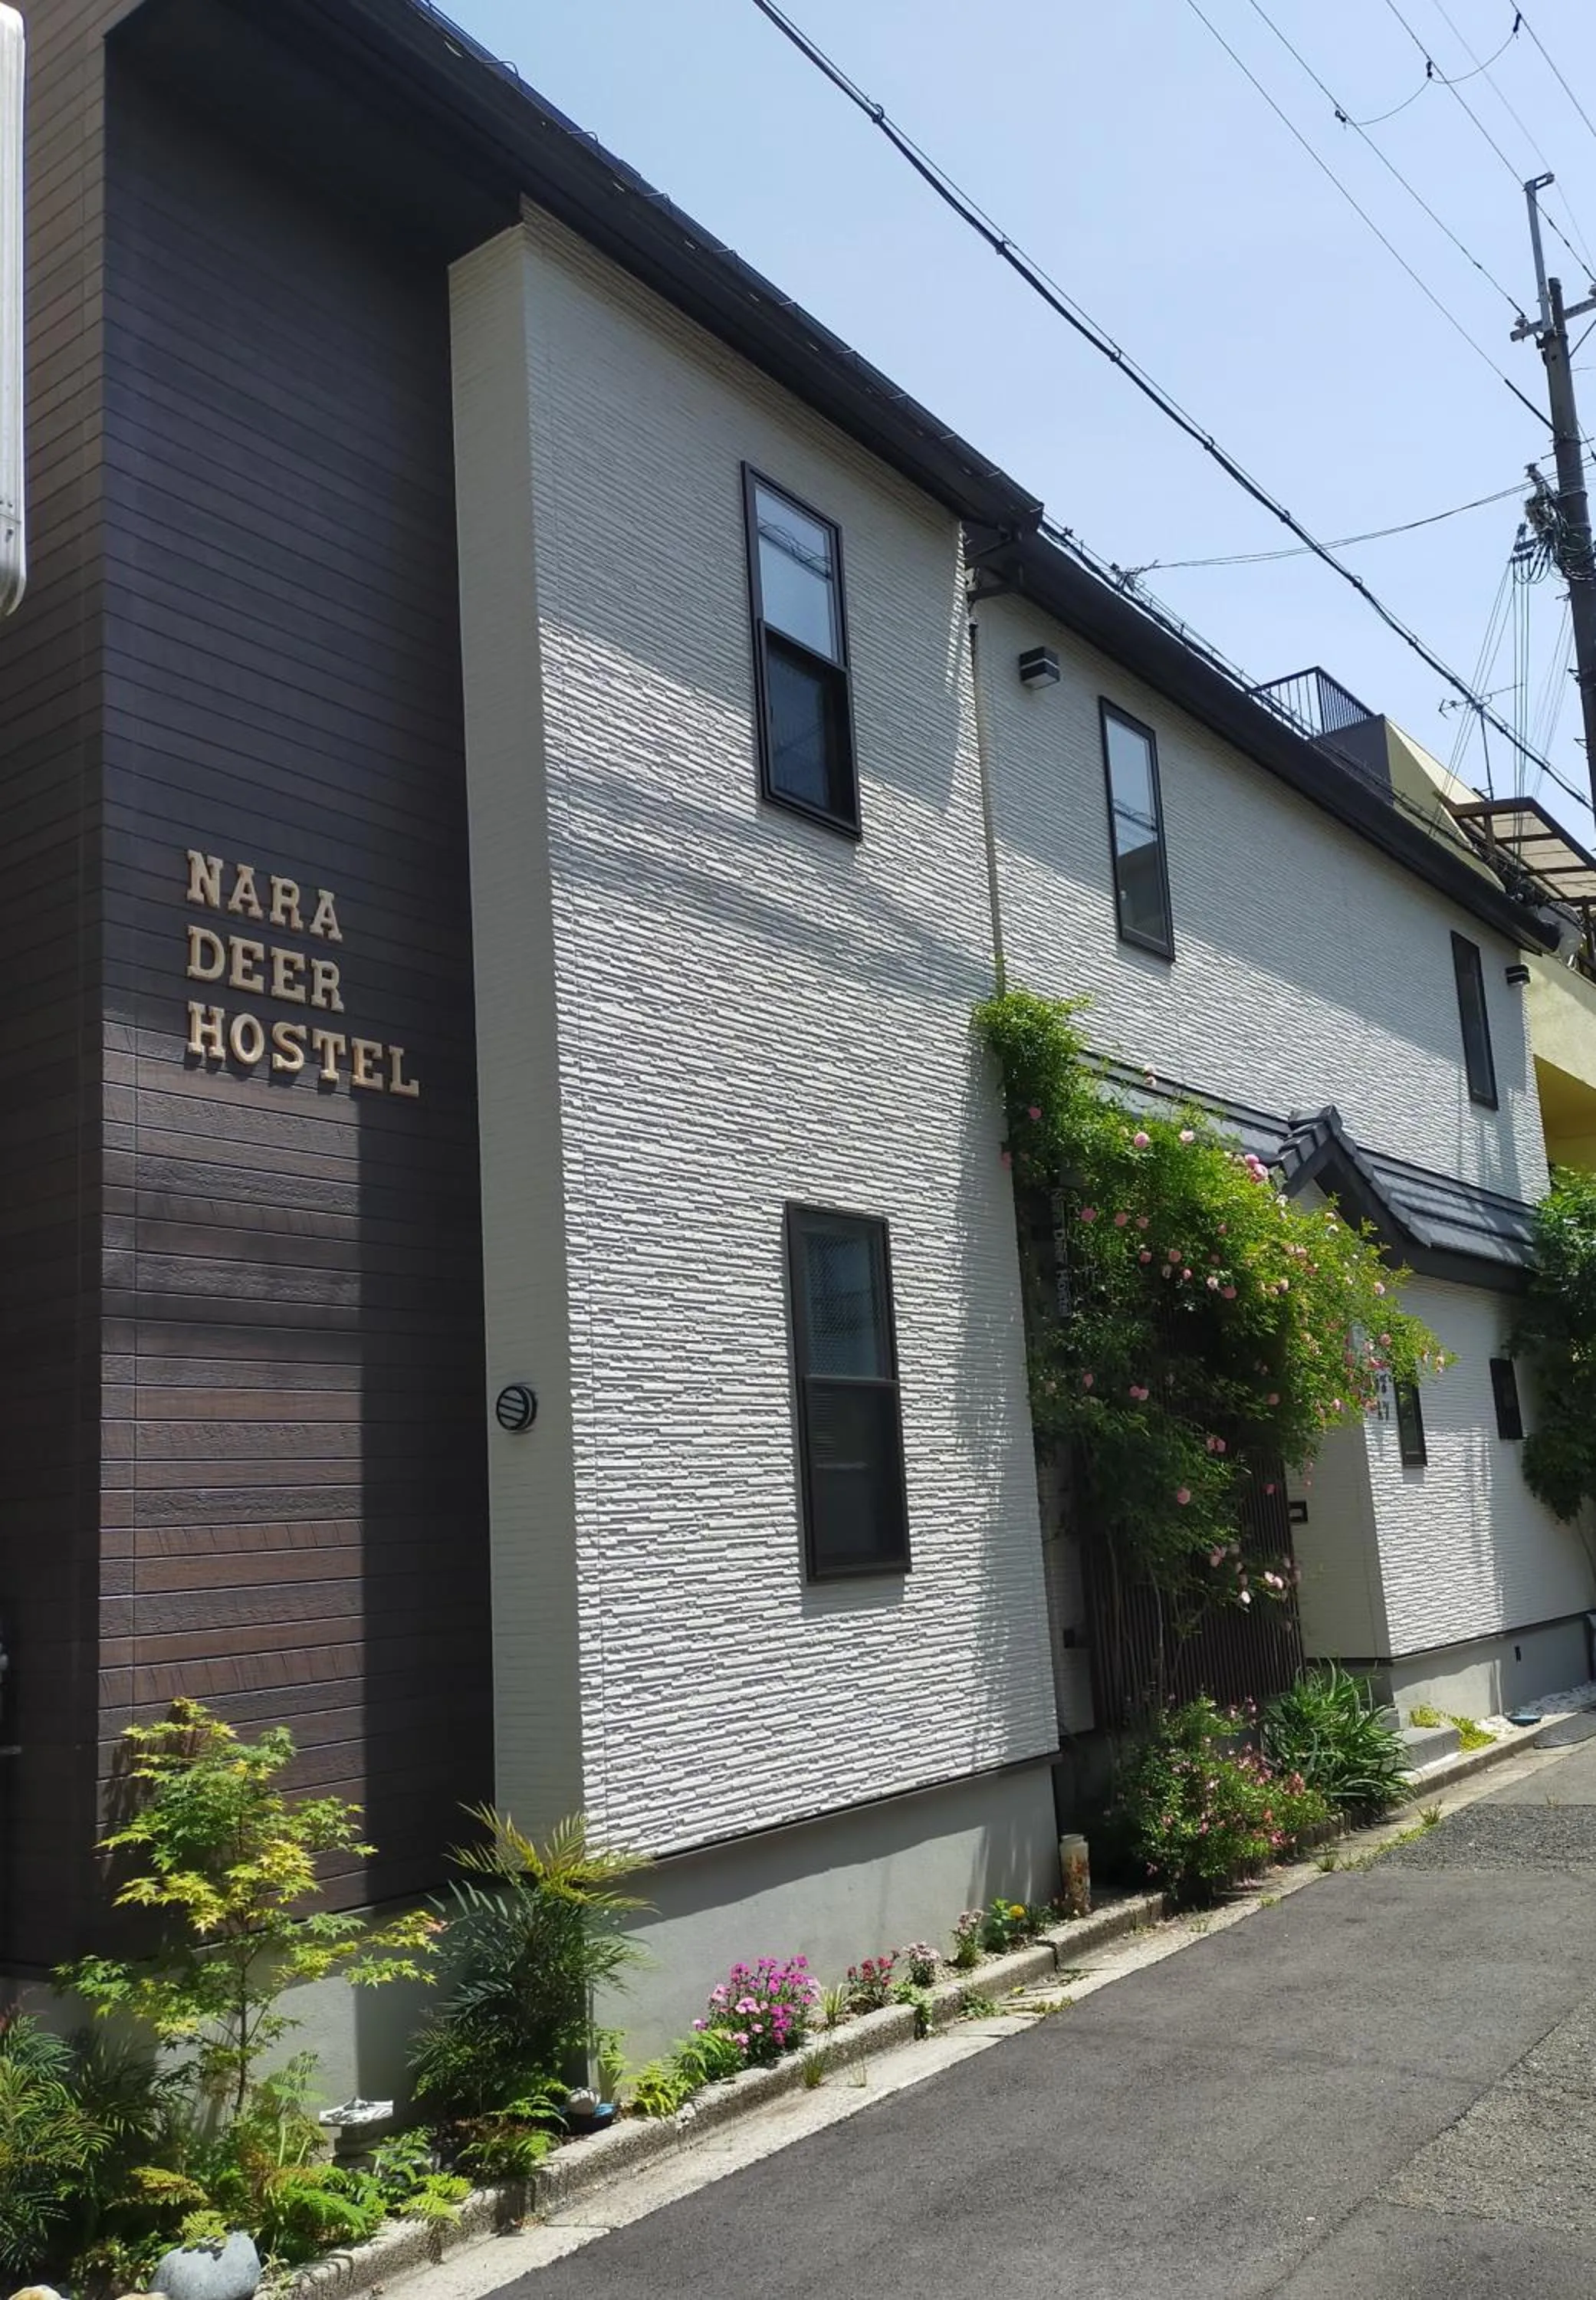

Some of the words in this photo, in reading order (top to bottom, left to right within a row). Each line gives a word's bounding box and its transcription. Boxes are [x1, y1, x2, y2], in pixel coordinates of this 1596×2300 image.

[187, 849, 343, 942] NARA
[187, 925, 344, 1012] DEER
[188, 1000, 419, 1097] HOSTEL
